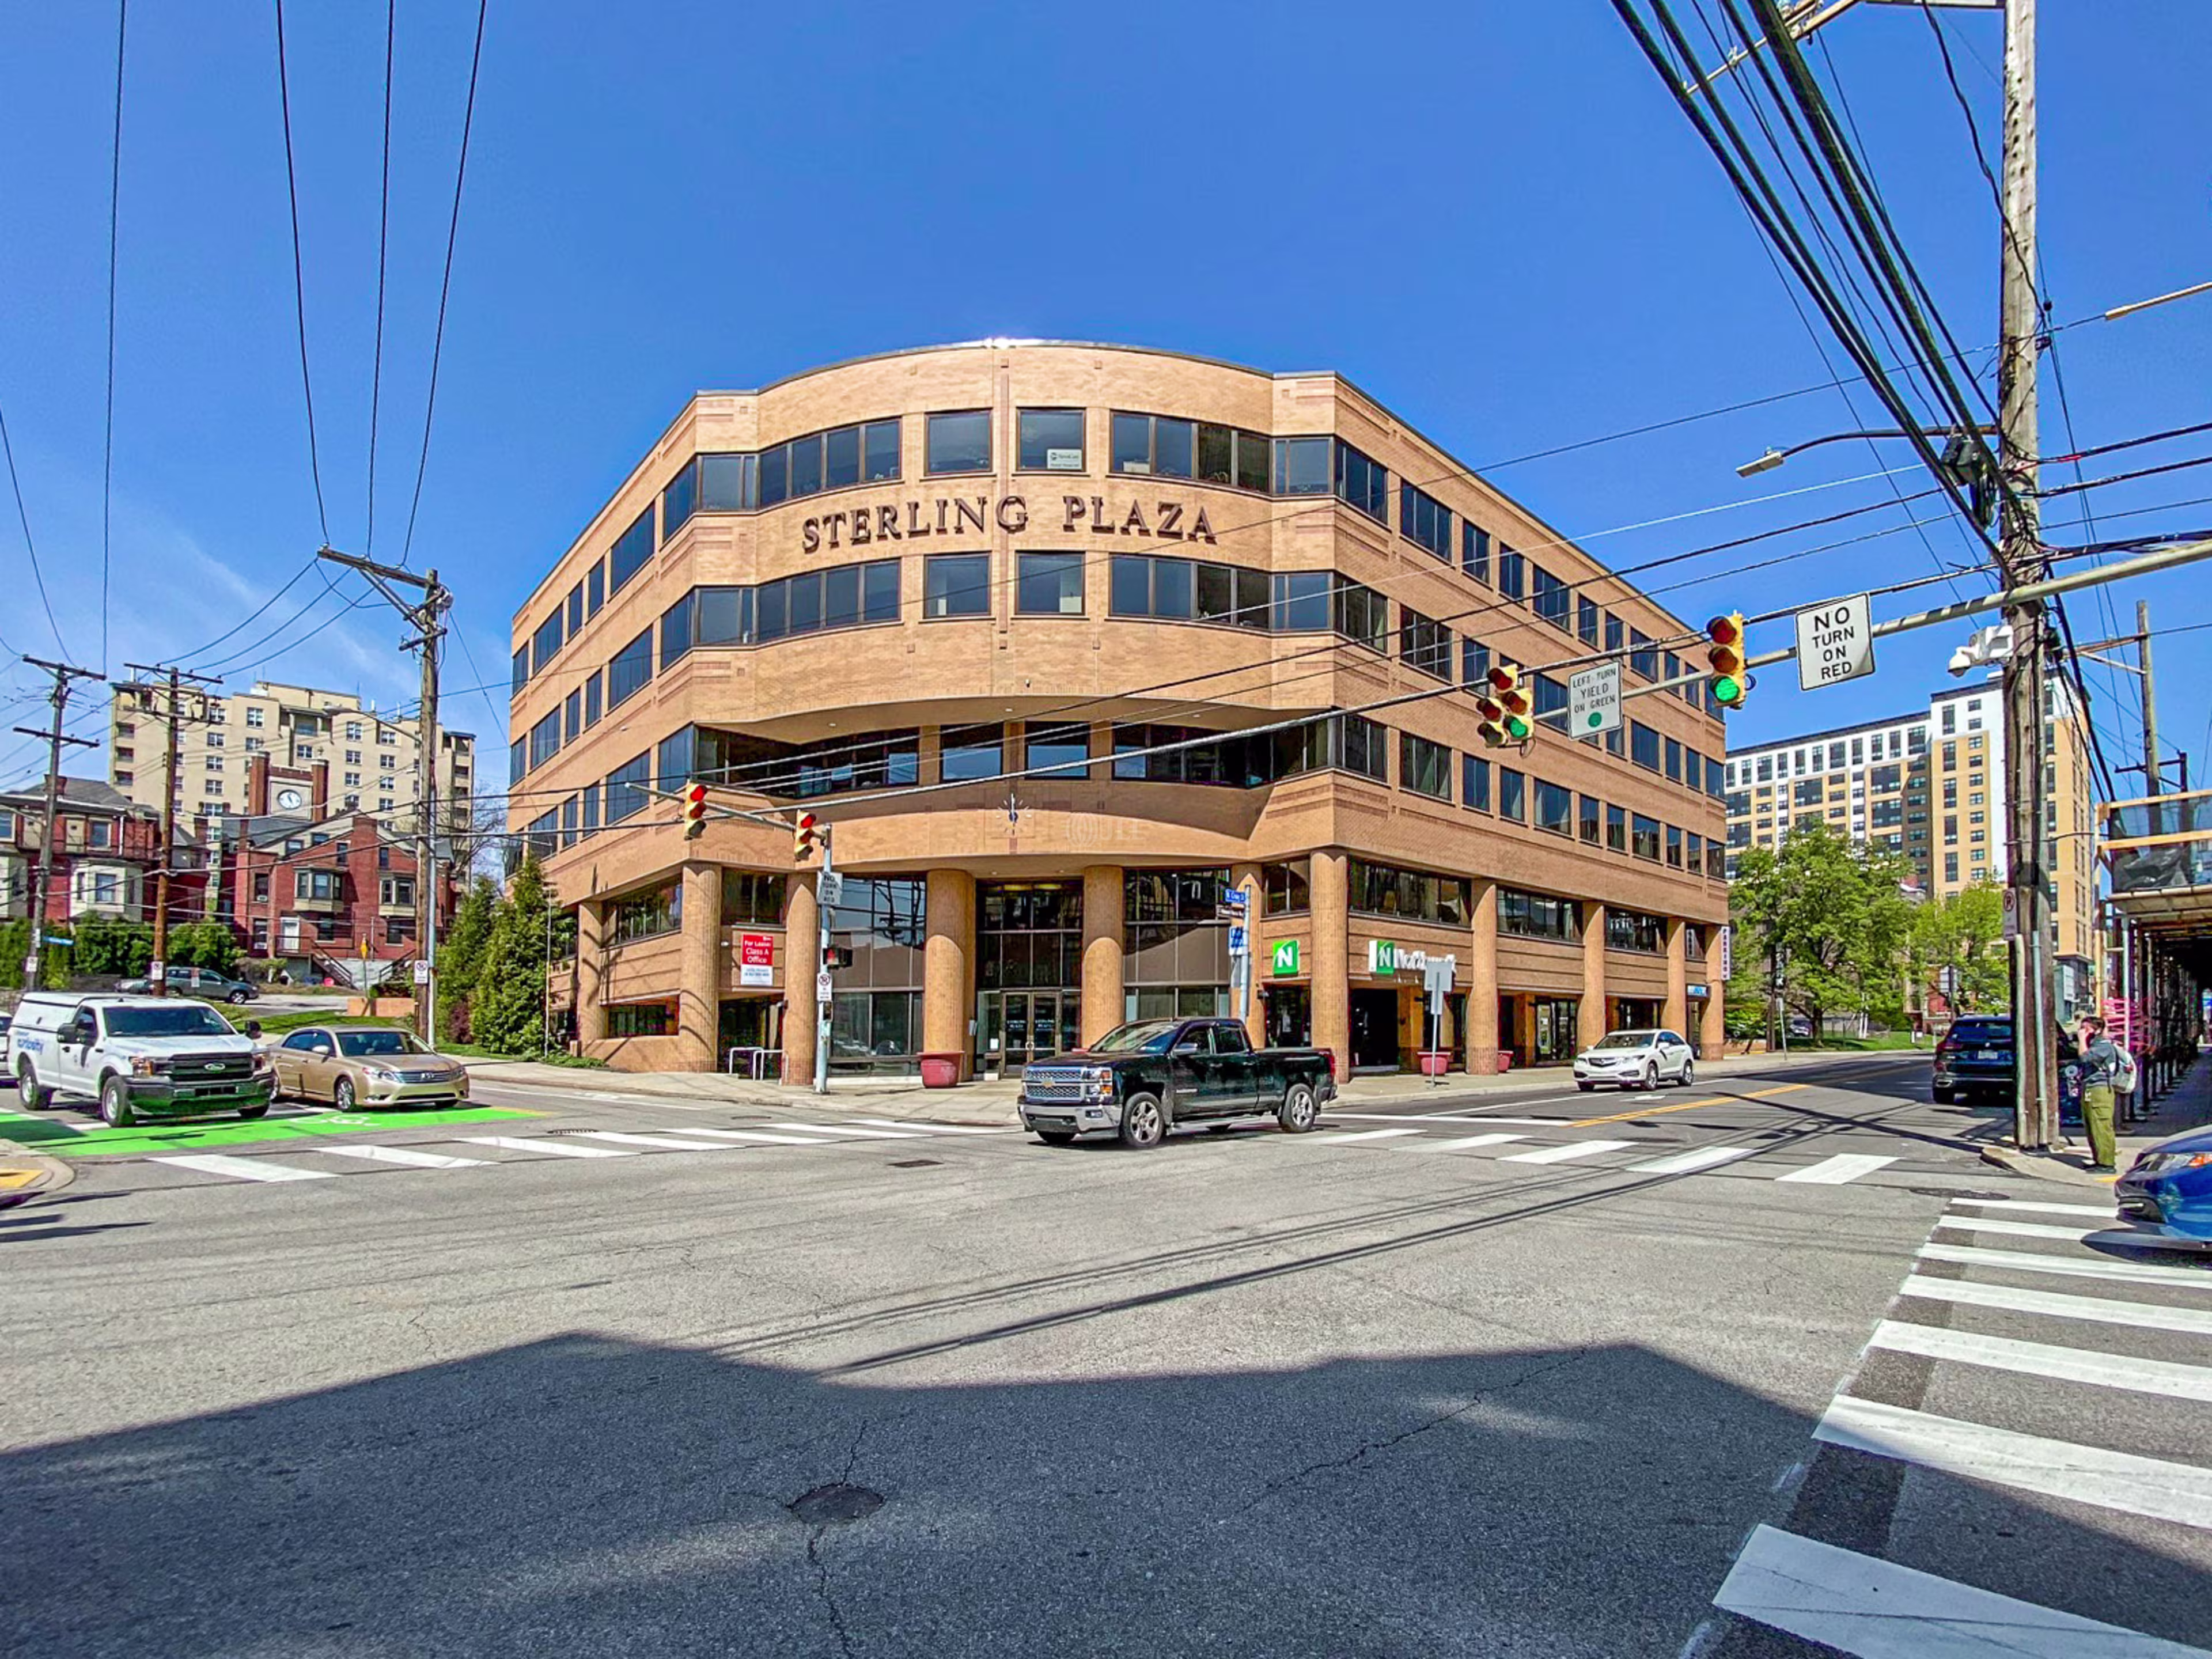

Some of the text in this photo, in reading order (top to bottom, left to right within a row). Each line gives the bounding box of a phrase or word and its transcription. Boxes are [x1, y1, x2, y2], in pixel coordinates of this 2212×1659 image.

[802, 495, 1217, 554] STERLING PLAZA
[1814, 607, 1850, 632] NO
[1812, 626, 1854, 649] TURN
[1823, 645, 1846, 662] ON
[1573, 668, 1616, 688] LEFT TURN
[1821, 661, 1852, 680] RED
[1581, 683, 1609, 699] YIELD
[1574, 694, 1615, 713] ON GREEN
[747, 956, 767, 964] Office
[1277, 946, 1293, 968] N
[1378, 947, 1392, 967] N
